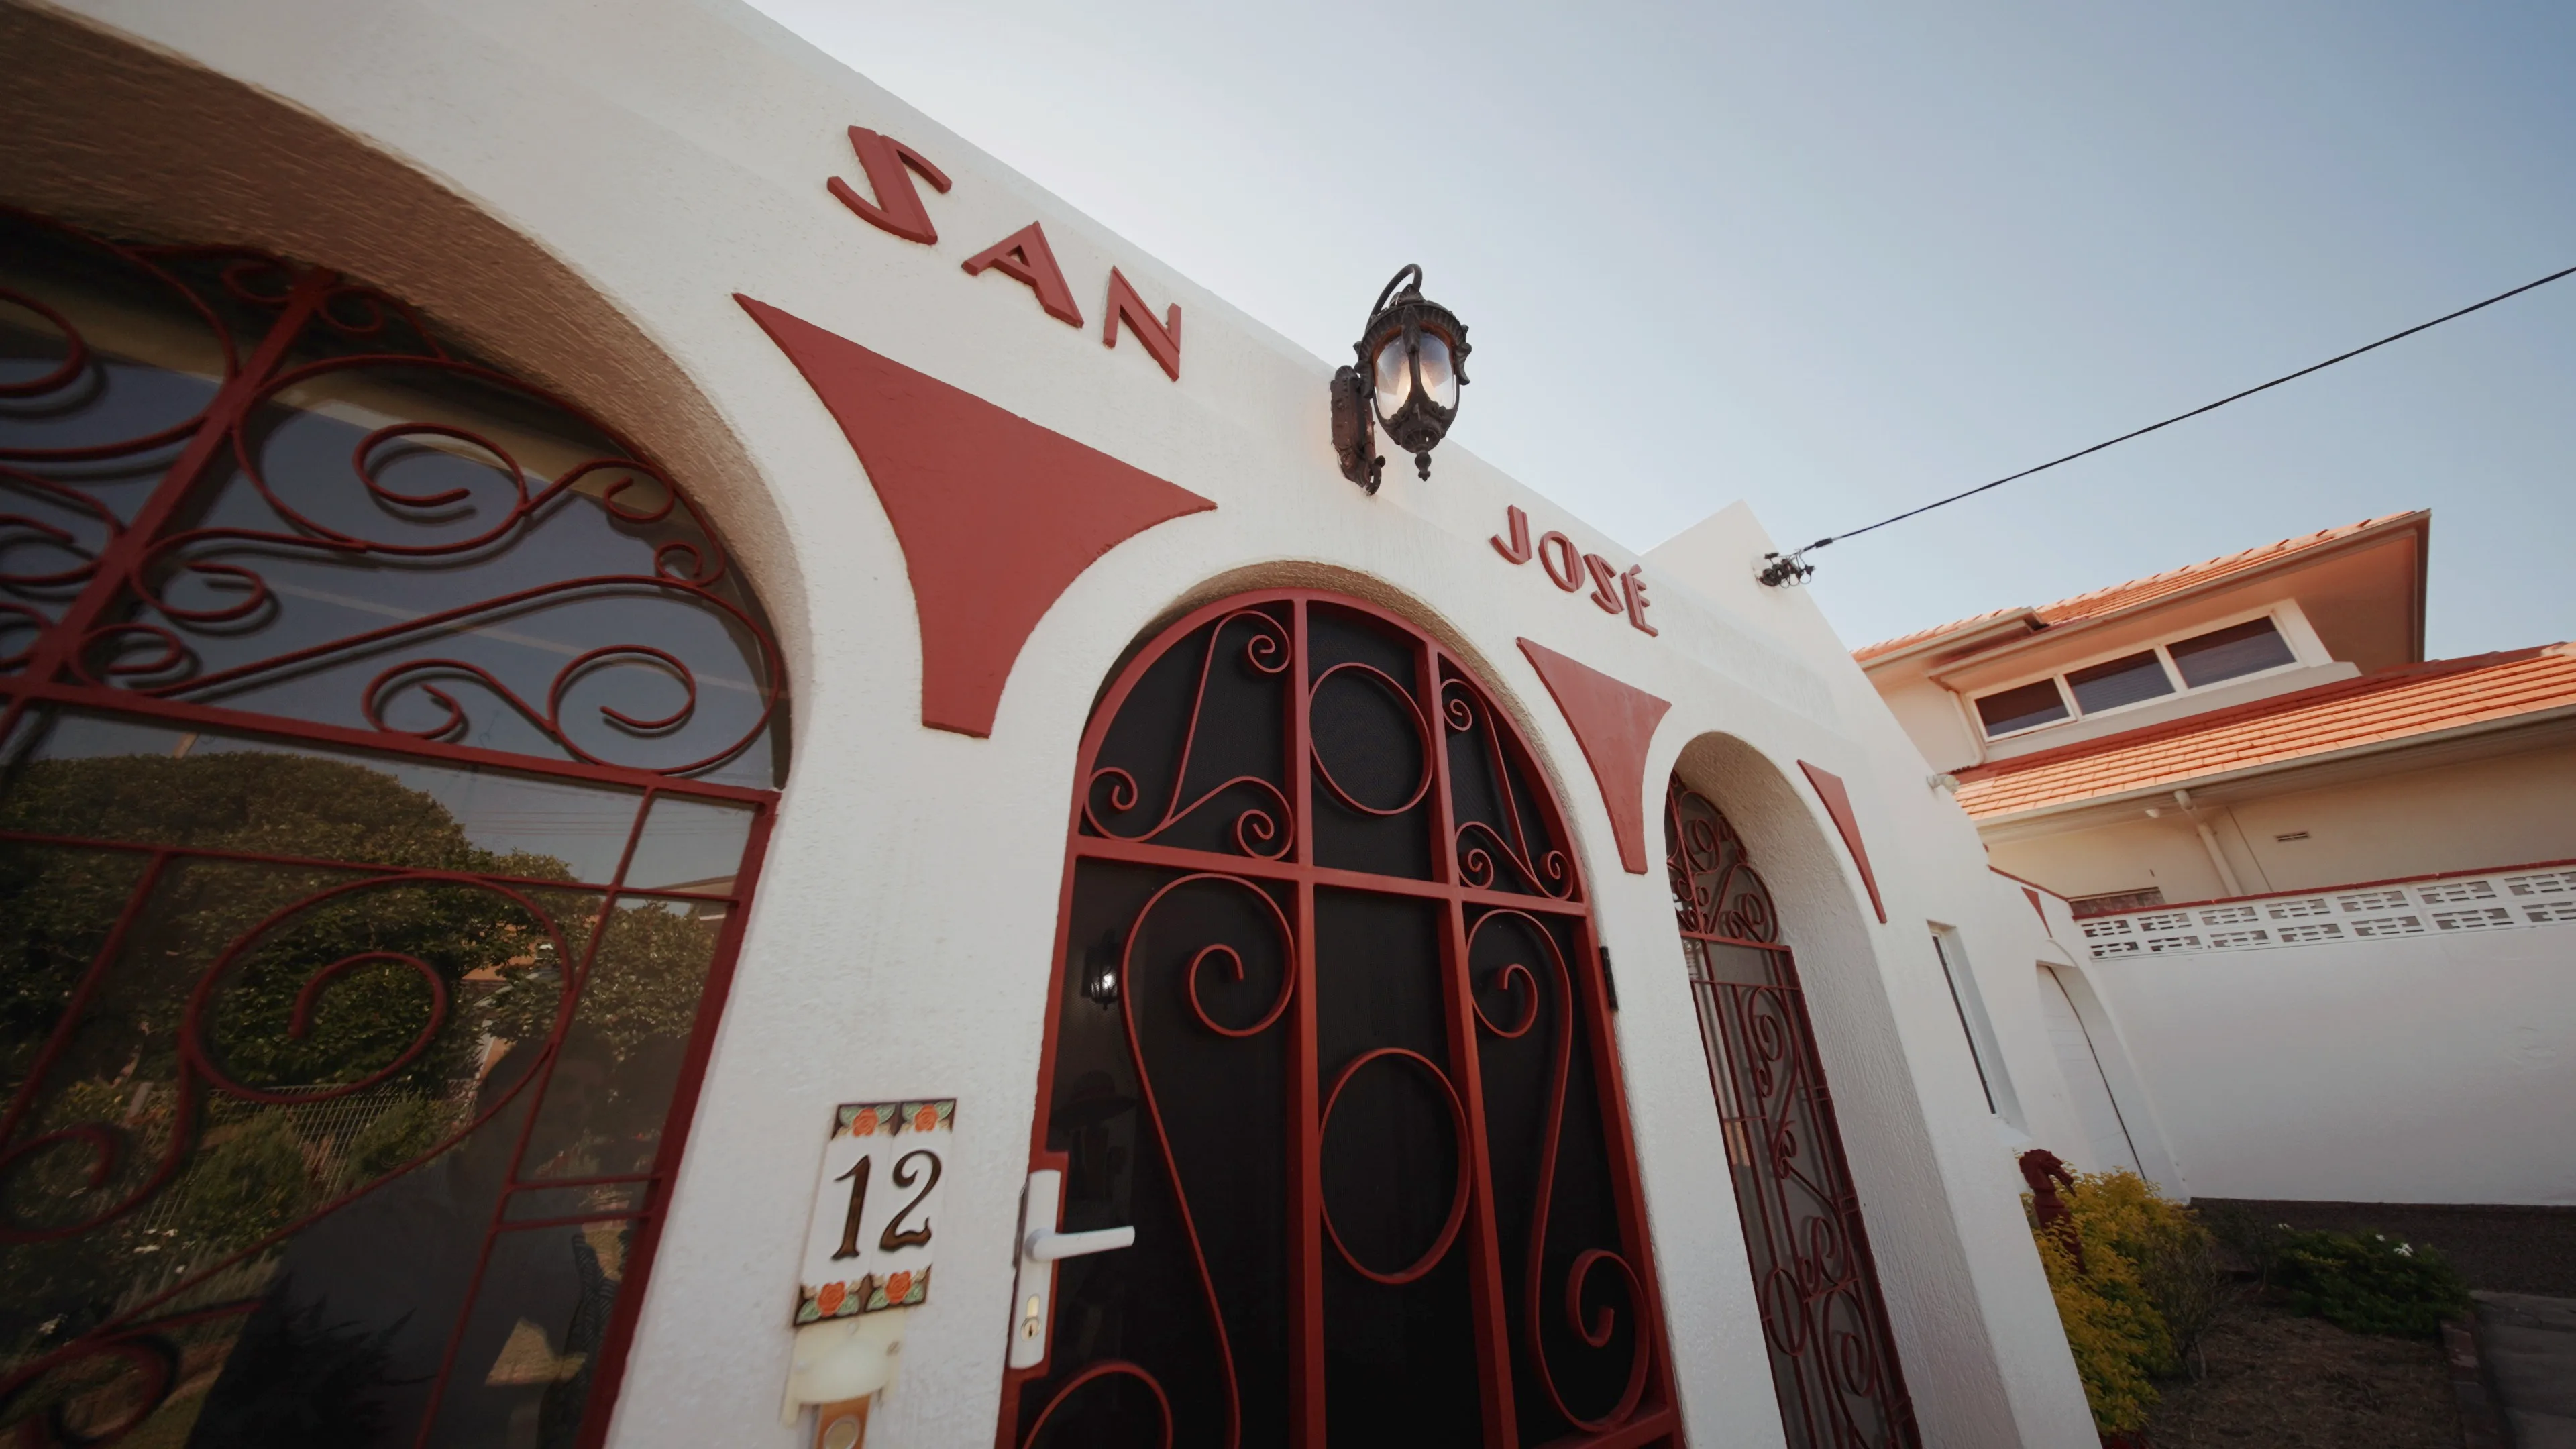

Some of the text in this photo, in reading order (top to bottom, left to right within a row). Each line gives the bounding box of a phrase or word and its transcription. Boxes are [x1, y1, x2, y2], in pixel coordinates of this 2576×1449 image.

[827, 125, 1659, 637] SAN JOSÉ
[830, 1149, 942, 1261] 12
